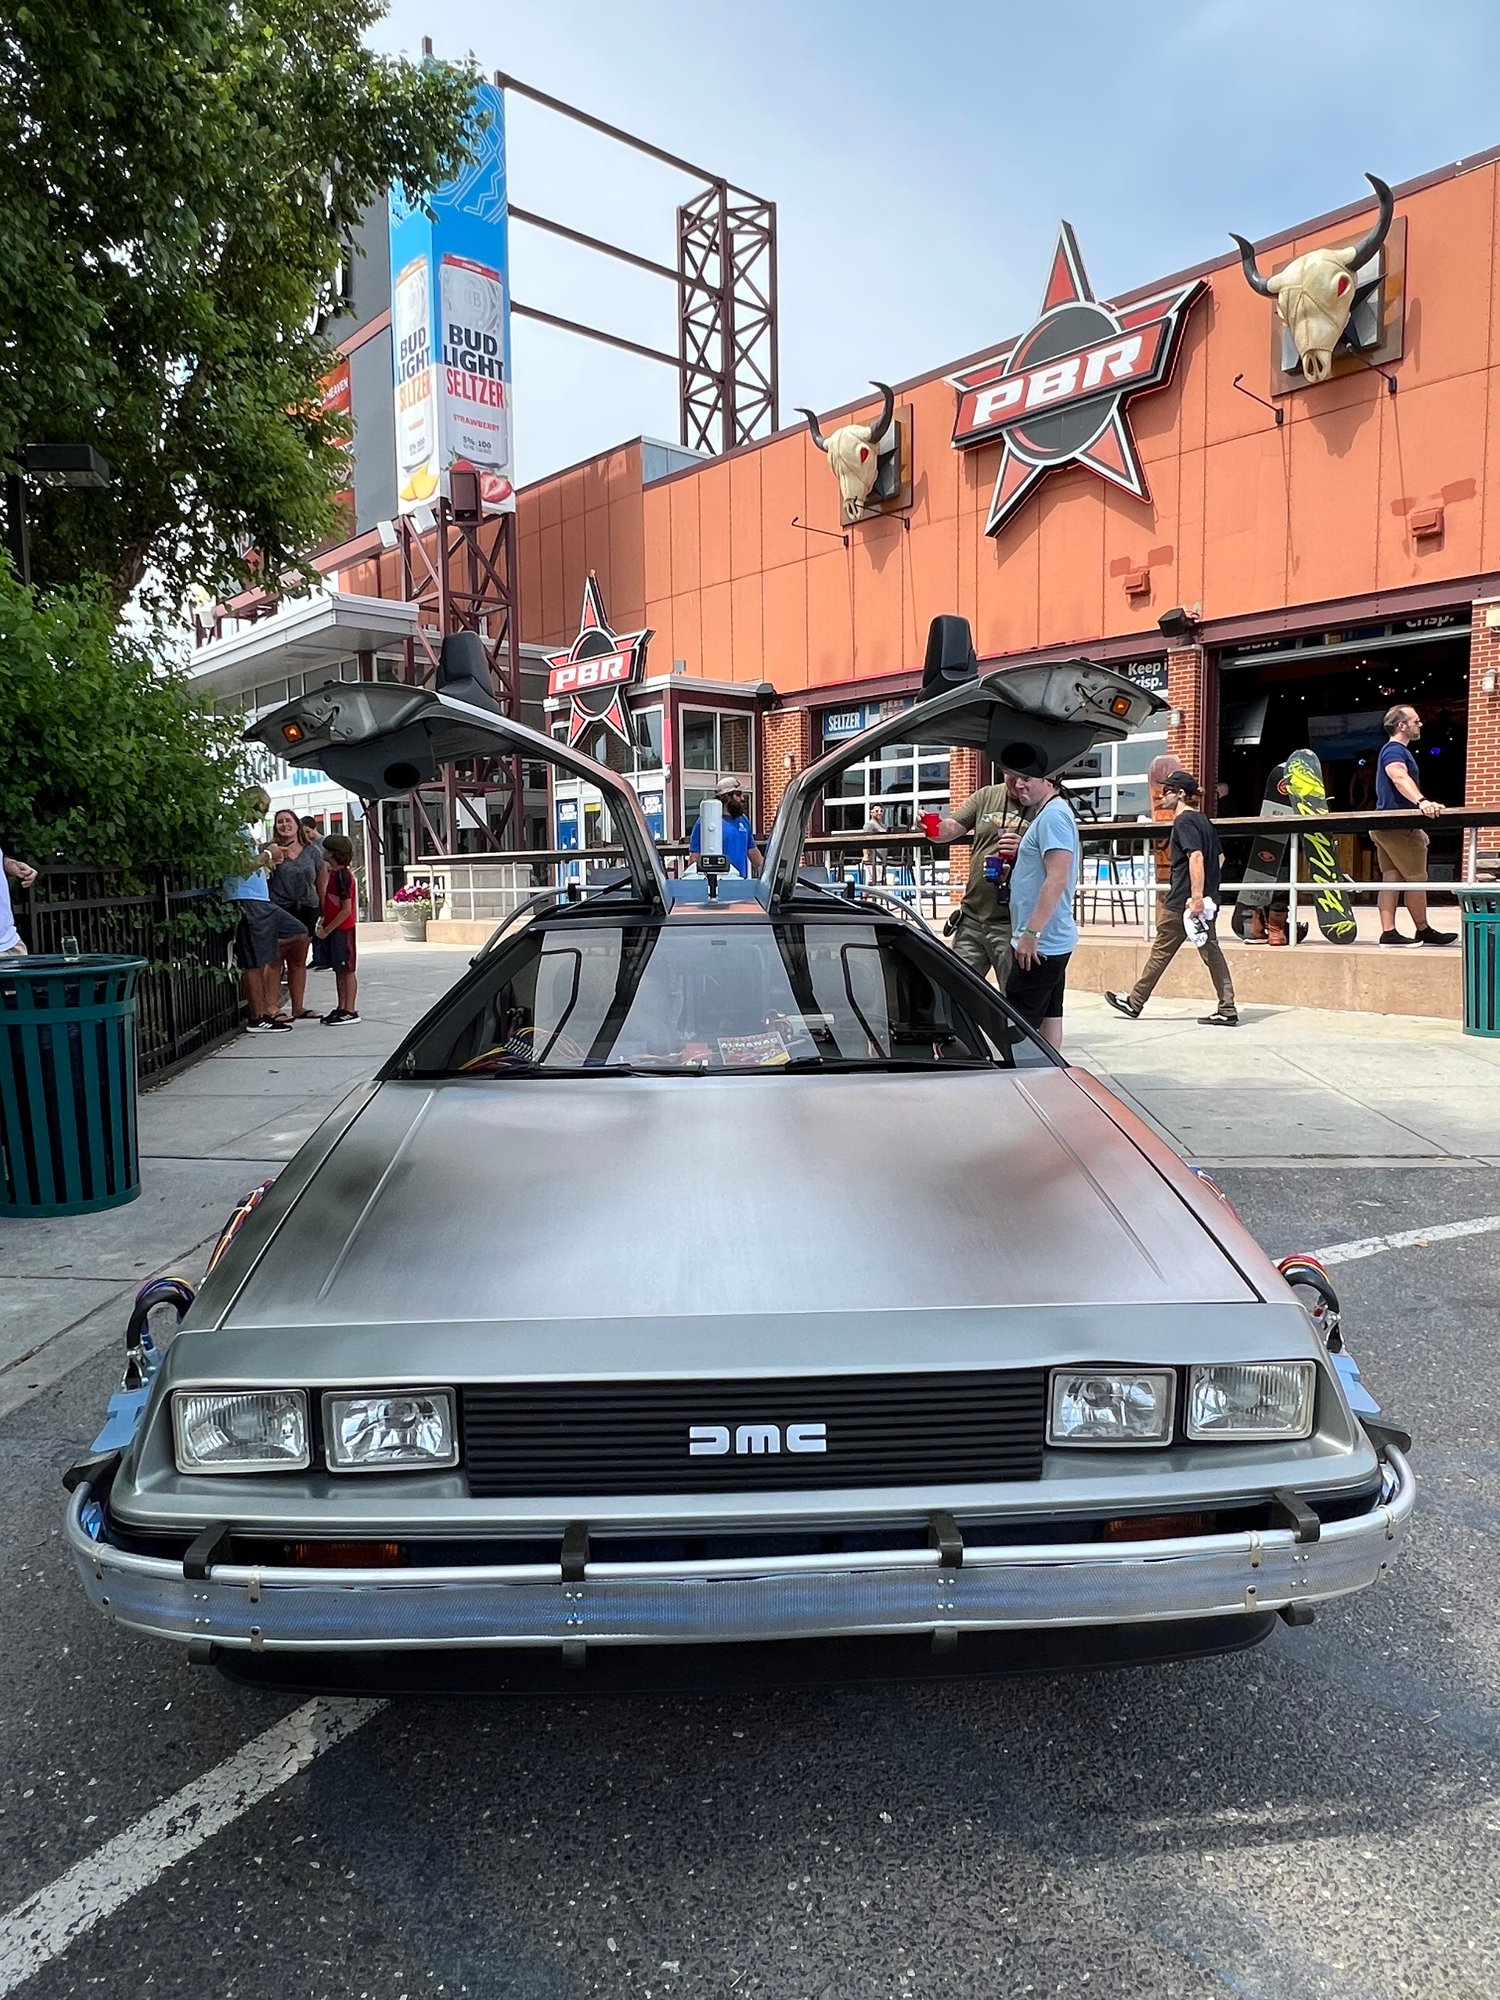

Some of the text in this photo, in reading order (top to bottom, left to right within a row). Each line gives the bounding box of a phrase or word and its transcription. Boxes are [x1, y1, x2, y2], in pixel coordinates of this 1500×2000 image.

[400, 326, 427, 360] BUD
[448, 323, 498, 356] BUD
[443, 344, 504, 381] LIGHT
[446, 368, 504, 408] SELTZER
[971, 335, 1143, 426] PBR
[453, 413, 500, 431] STRAWBERRY
[478, 440, 492, 449] 100
[555, 656, 624, 691] PBR
[1128, 662, 1161, 675] Keep
[828, 712, 860, 731] SELTZER
[721, 1038, 778, 1049] ALMANAC
[689, 1423, 827, 1455] DMC
